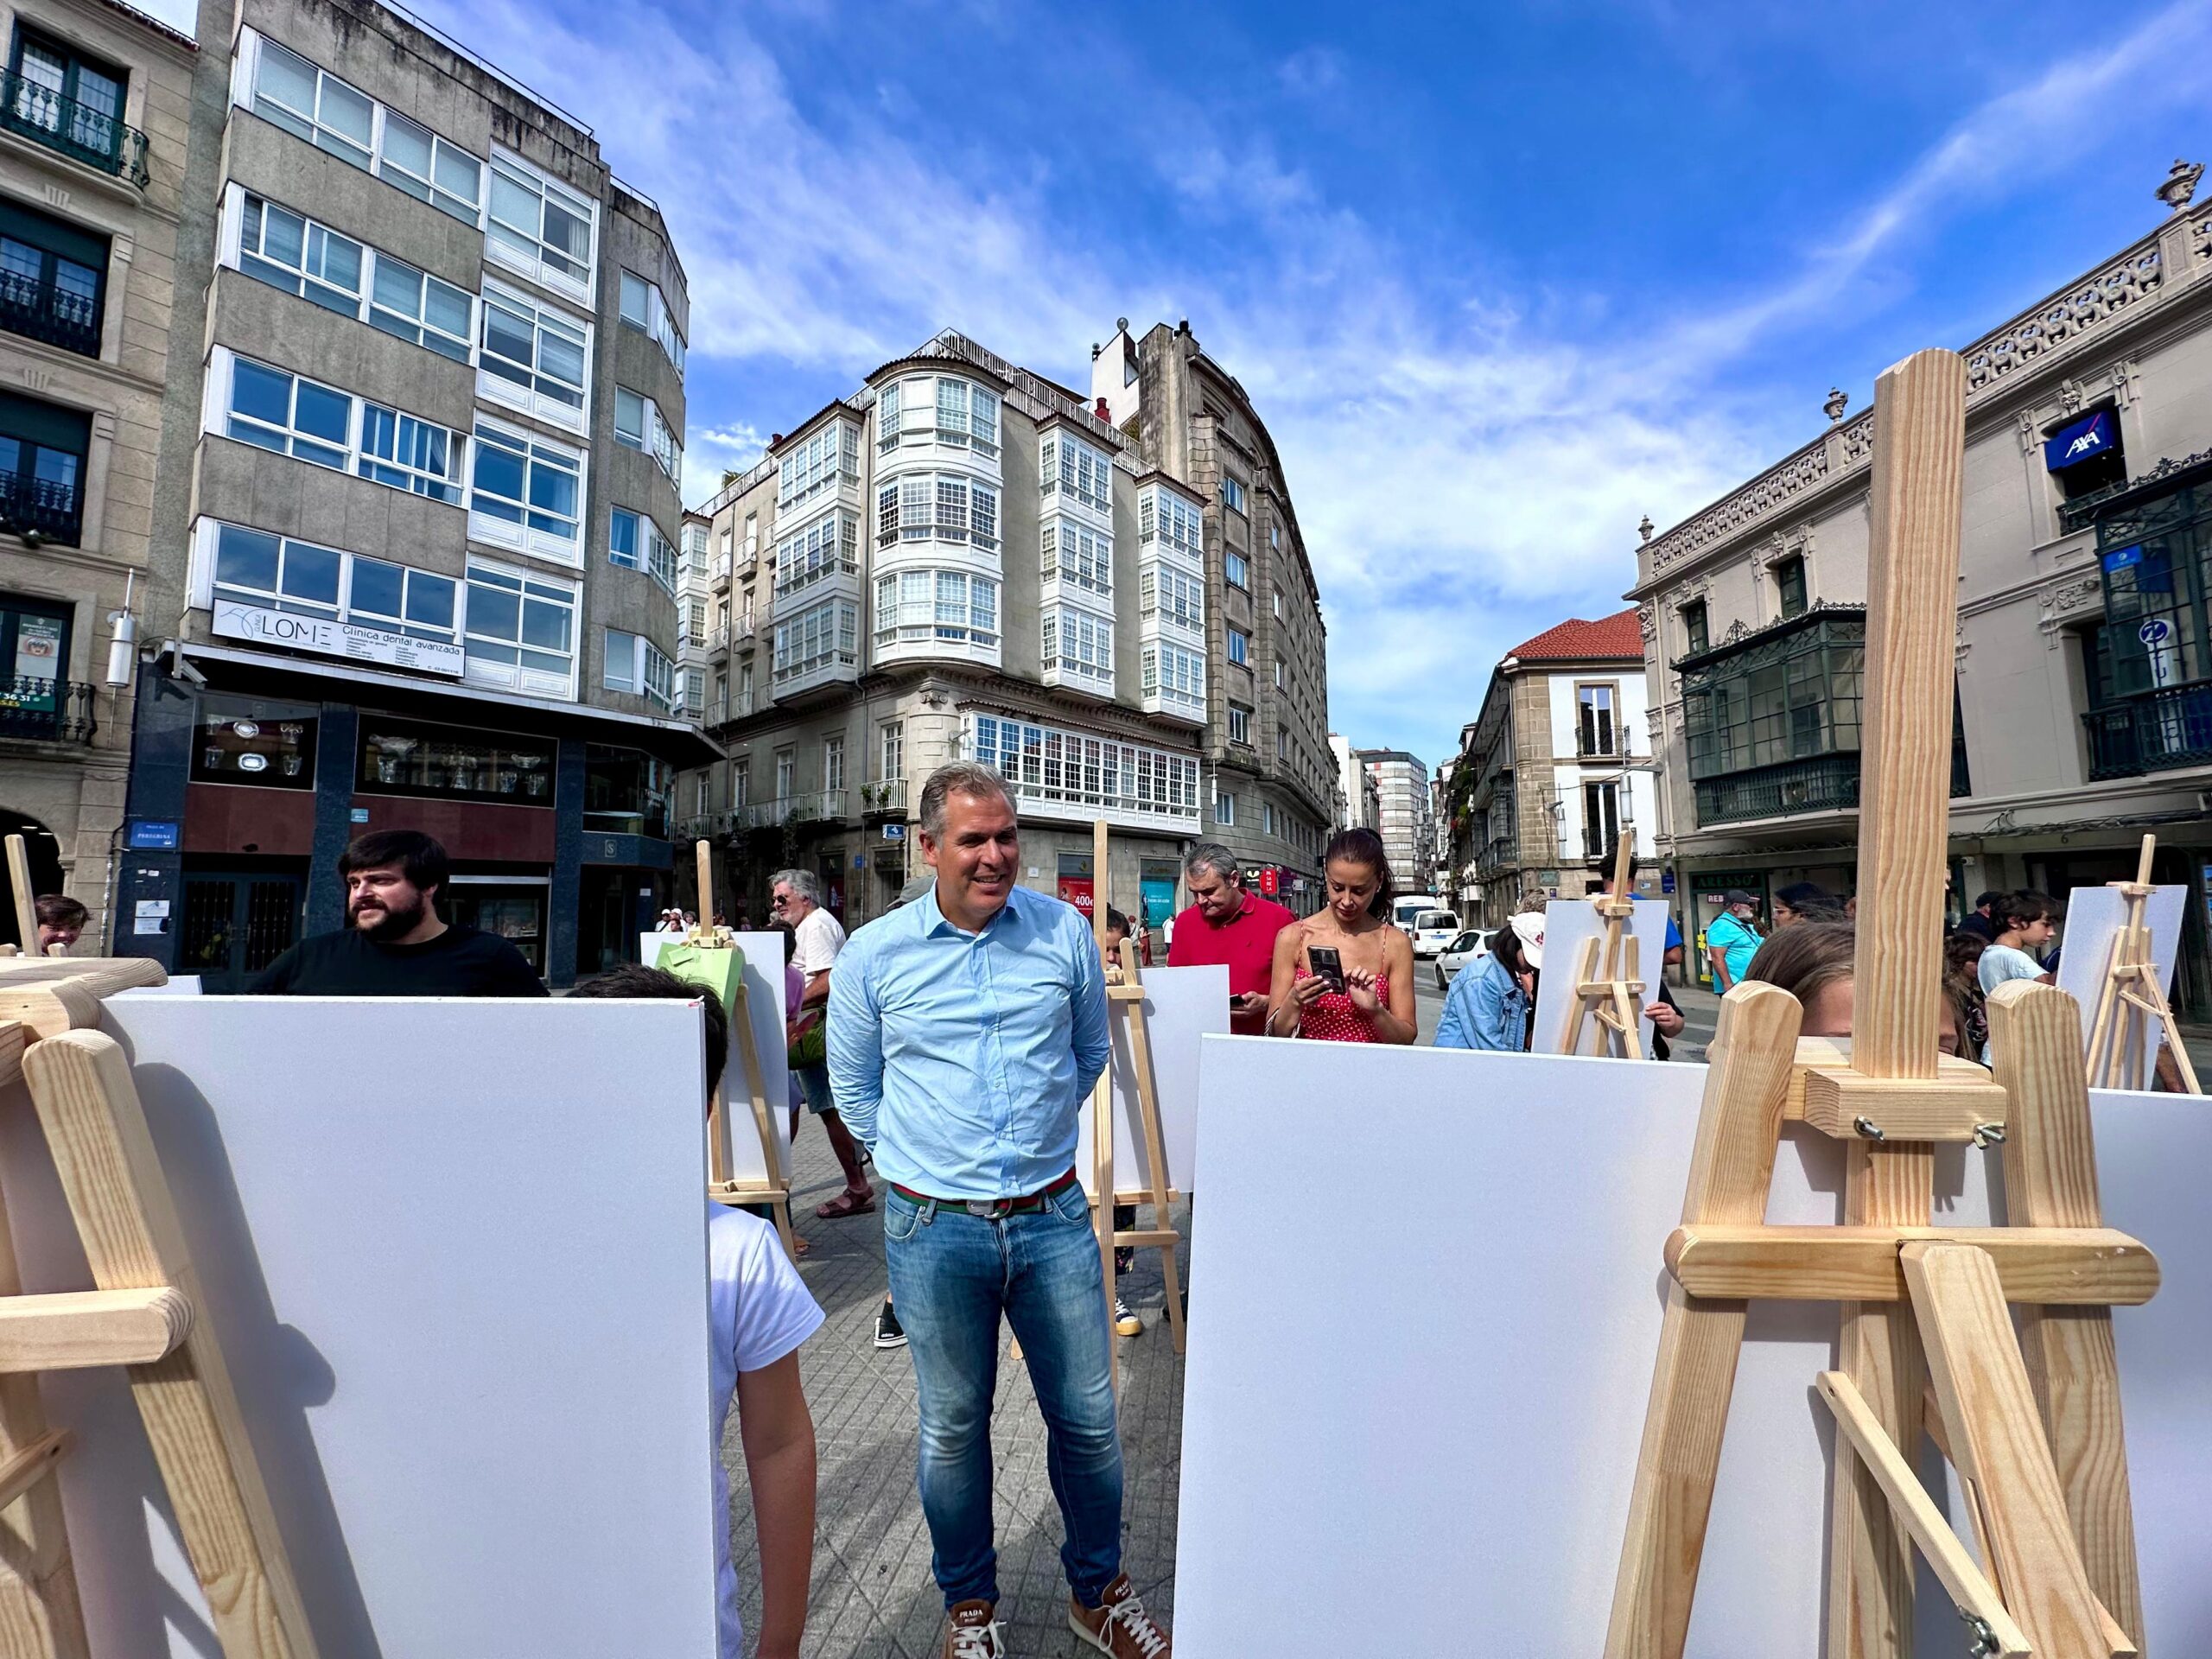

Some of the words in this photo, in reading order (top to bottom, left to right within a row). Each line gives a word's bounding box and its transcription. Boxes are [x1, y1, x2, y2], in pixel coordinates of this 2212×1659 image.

[2065, 431, 2101, 458] AXA
[262, 615, 332, 645] LOME
[383, 634, 412, 646] dental
[416, 640, 460, 656] avanzada
[2061, 835, 2069, 844] 6
[959, 1609, 983, 1618] PRADA
